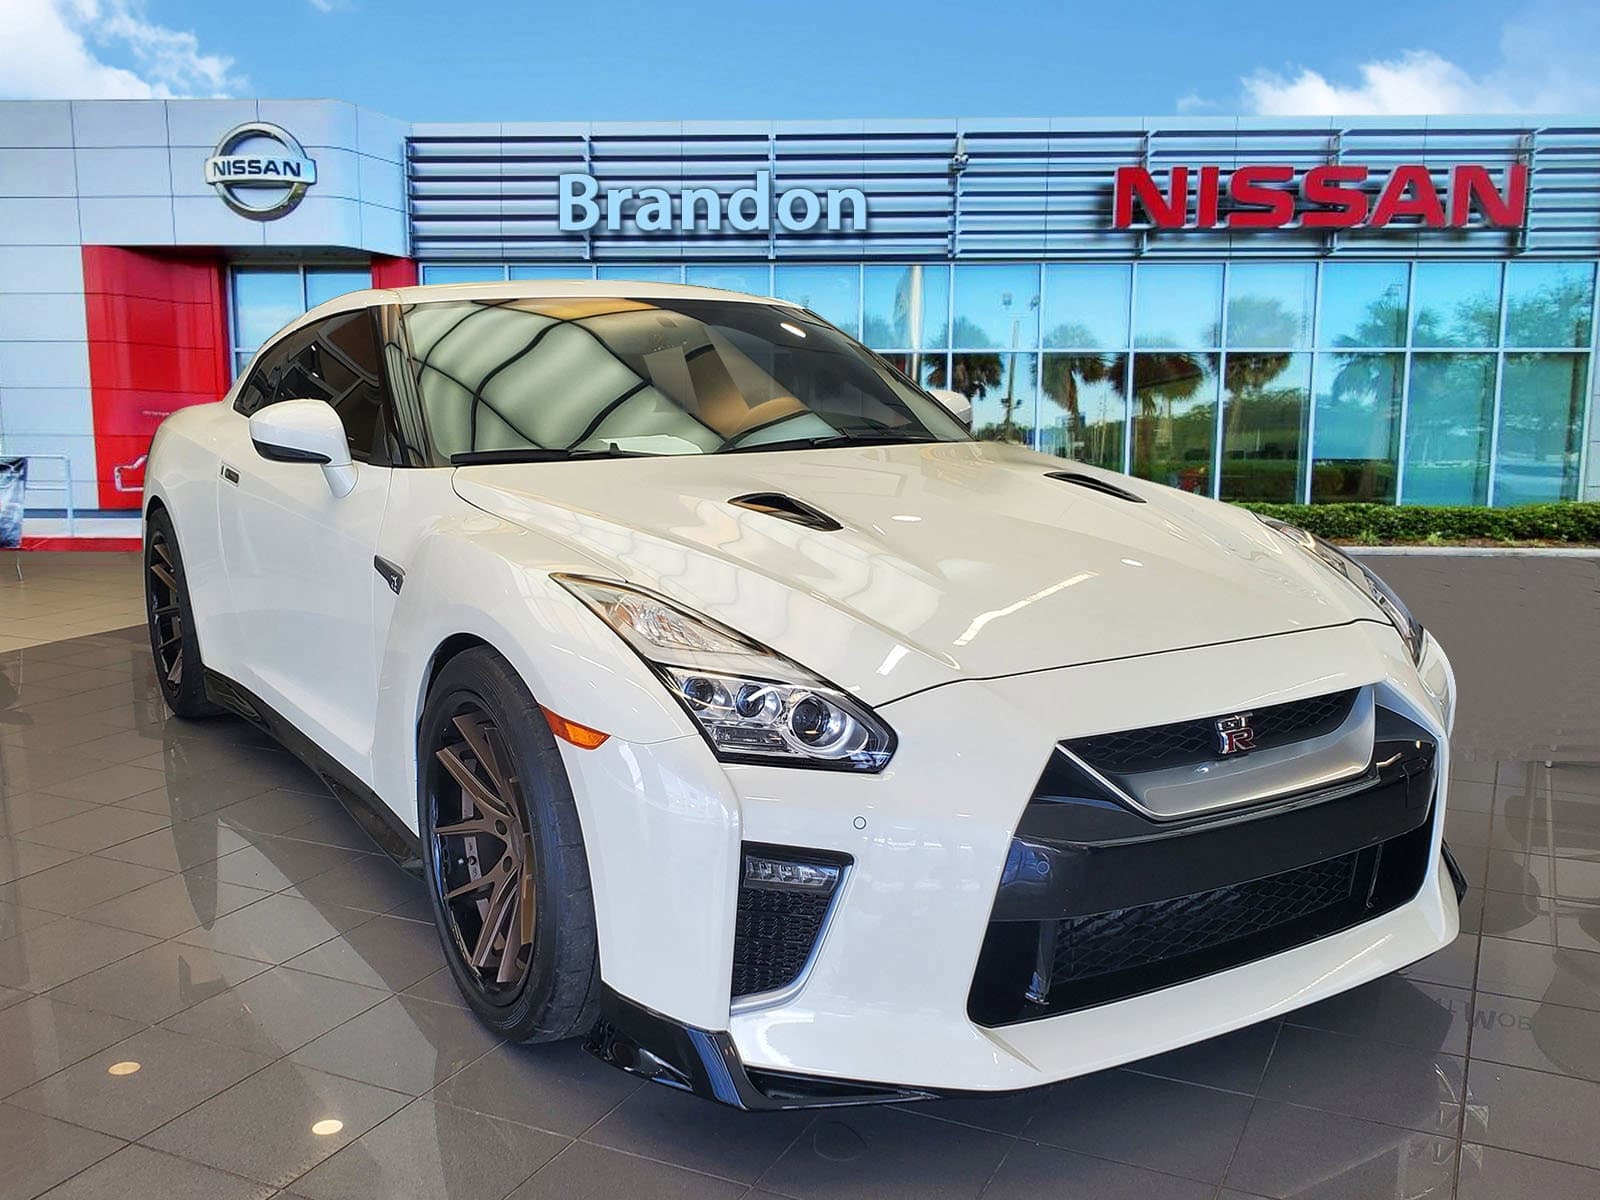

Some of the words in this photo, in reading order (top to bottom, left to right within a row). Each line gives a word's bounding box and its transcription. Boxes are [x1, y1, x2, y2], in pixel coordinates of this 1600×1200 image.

[213, 159, 301, 177] NISSAN
[1112, 164, 1529, 229] NISSAN
[558, 170, 868, 232] Brandon
